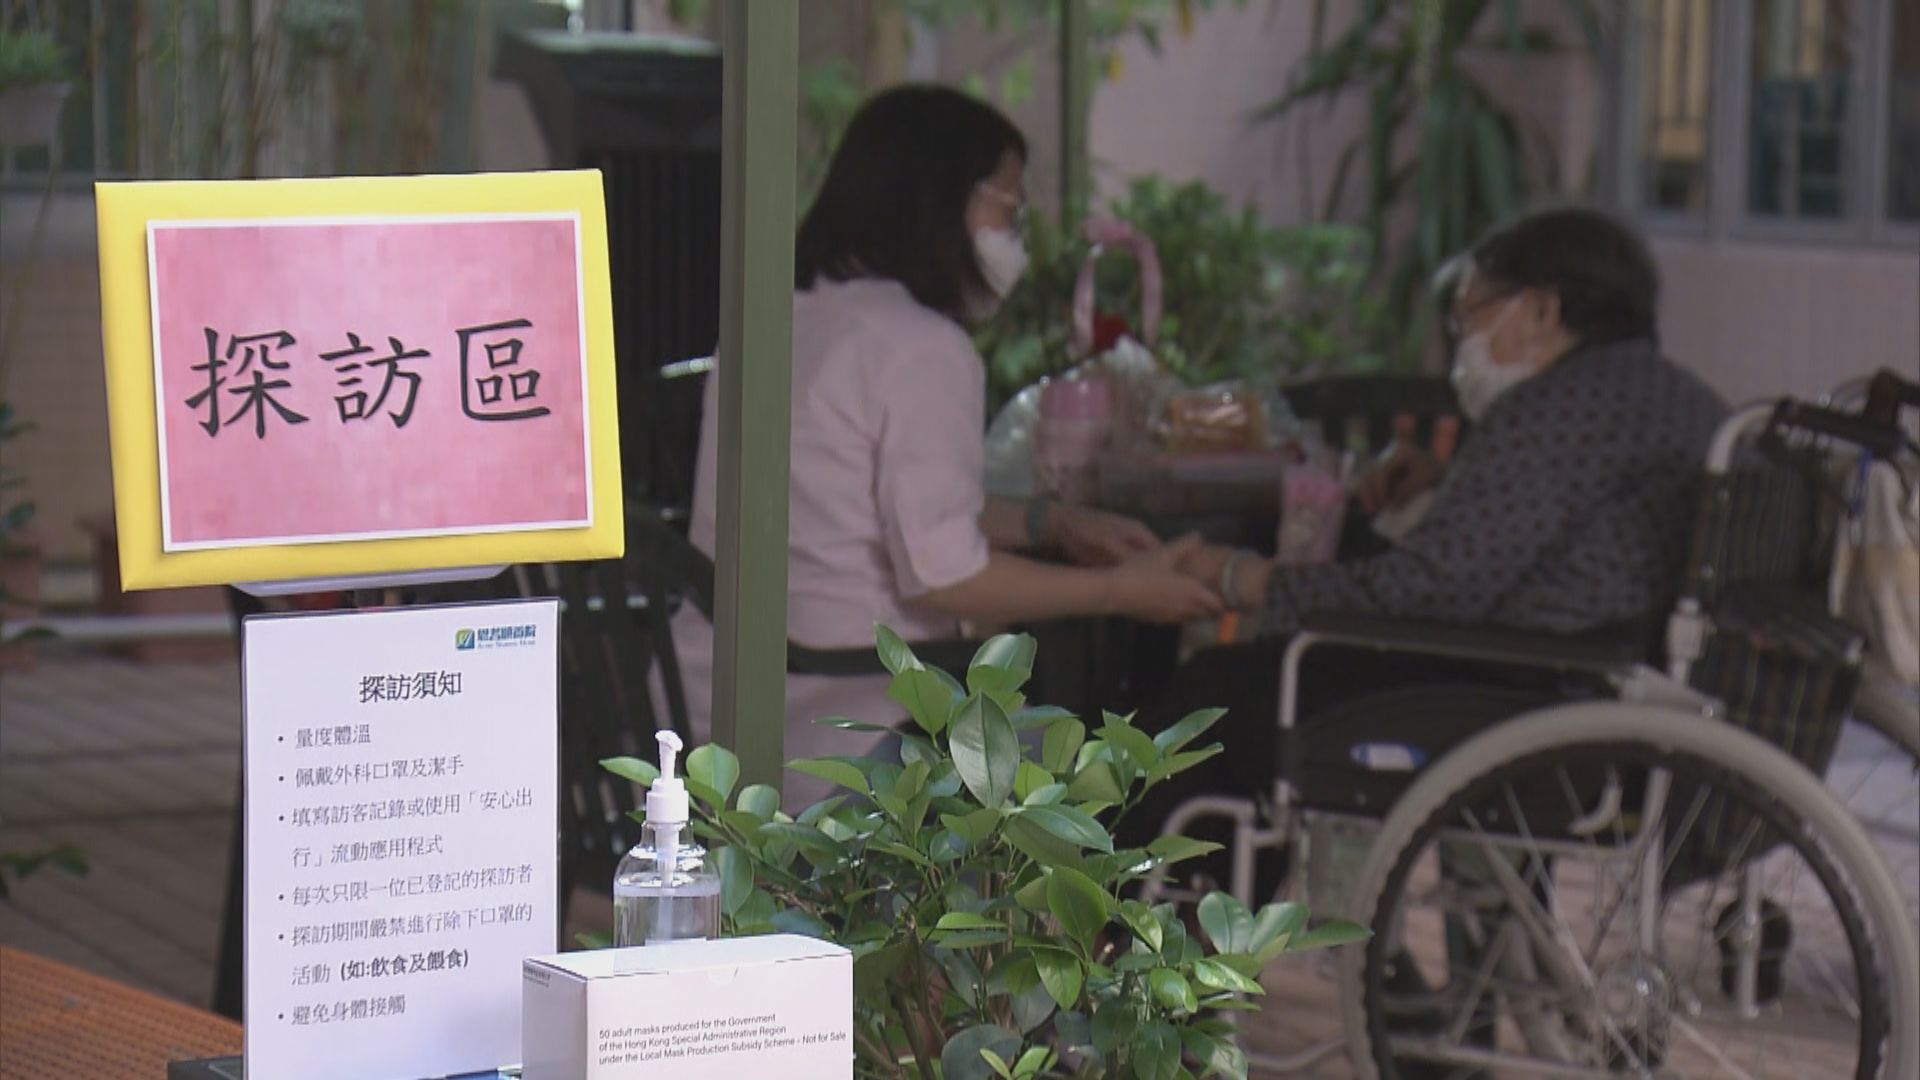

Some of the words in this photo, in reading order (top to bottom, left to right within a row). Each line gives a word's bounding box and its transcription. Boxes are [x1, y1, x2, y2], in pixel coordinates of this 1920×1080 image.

[184, 318, 551, 439] 探訪區
[359, 670, 463, 703] 探訪須知
[296, 723, 371, 749] 量度體溫
[296, 754, 464, 788] 佩戴外科口罩及潔手
[292, 863, 533, 906] 每次只限一位已登記的探訪者
[292, 903, 532, 947] 探訪期間嚴禁進行除下口罩的
[291, 963, 330, 986] 活動
[292, 995, 405, 1025] 避免身體接觸
[599, 1029, 610, 1039] 50
[612, 1027, 632, 1038] adult
[634, 1024, 660, 1035] masks
[662, 1020, 699, 1034] produced
[701, 1019, 711, 1029] for
[713, 1018, 726, 1029] the
[728, 1014, 776, 1027] Government
[599, 1042, 608, 1052] of
[609, 1041, 622, 1051] the
[625, 1039, 647, 1050] Hong
[649, 1037, 670, 1048] Kong
[672, 1033, 700, 1046] Special
[702, 1028, 757, 1042] Administrative
[759, 1025, 786, 1037] Region
[599, 1054, 623, 1065] under
[625, 1052, 638, 1062] the
[640, 1049, 662, 1061] Local
[664, 1047, 685, 1058] Mask
[687, 1043, 729, 1056] Production
[731, 1039, 762, 1051] Subsidy
[764, 1037, 795, 1049] Scheme
[802, 1034, 816, 1045] Not
[818, 1032, 828, 1043] for
[830, 1030, 846, 1041] Sale
